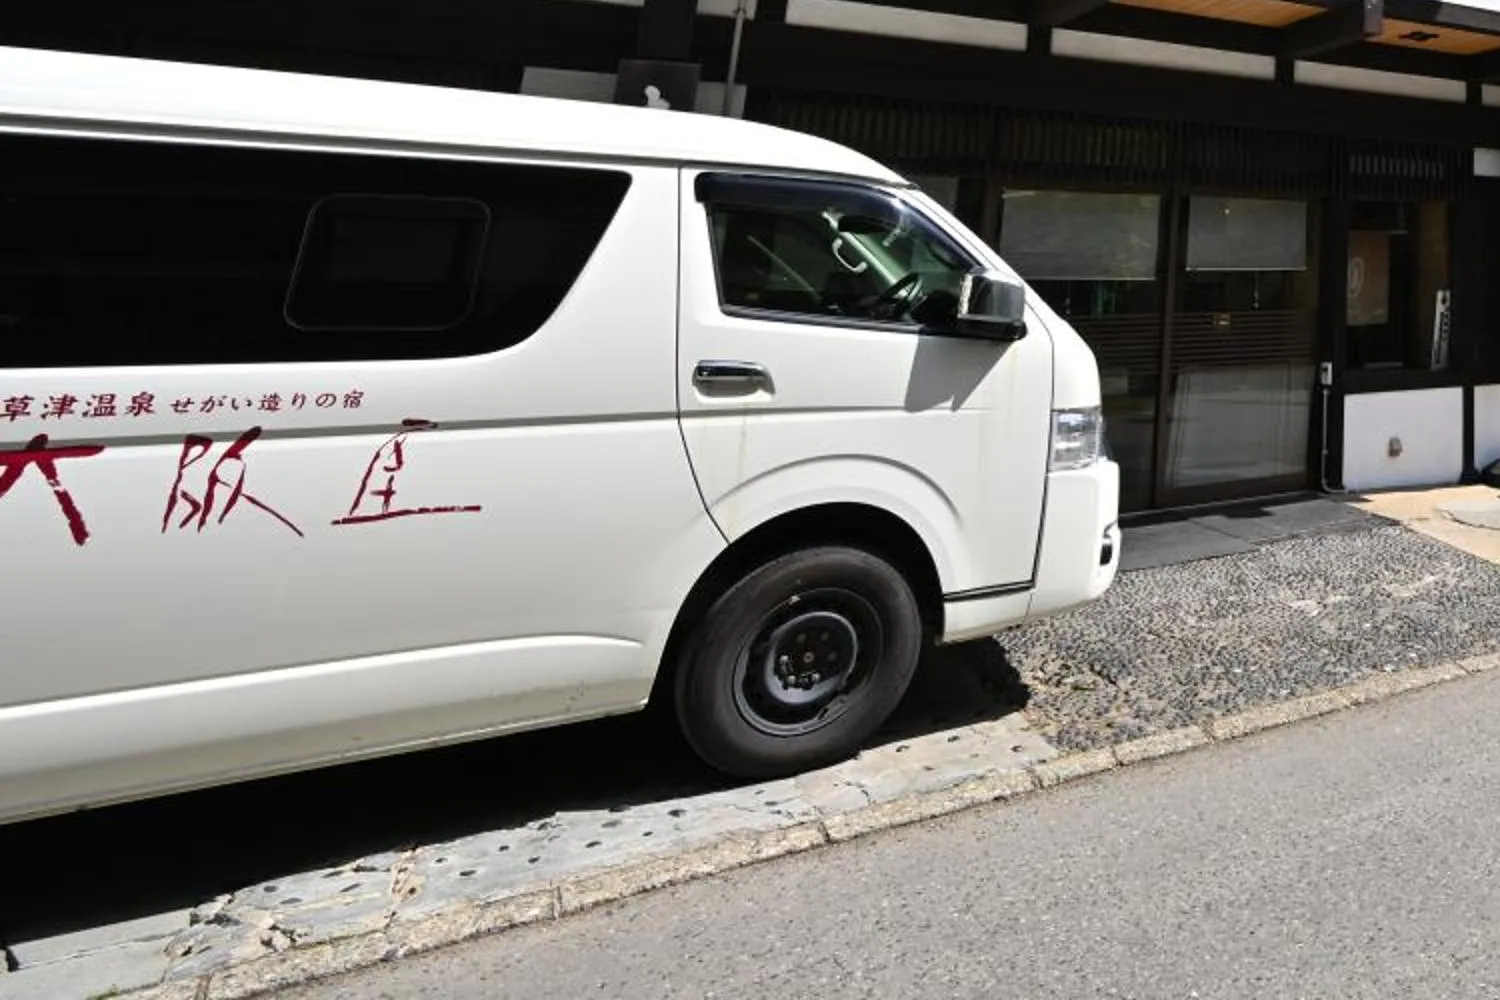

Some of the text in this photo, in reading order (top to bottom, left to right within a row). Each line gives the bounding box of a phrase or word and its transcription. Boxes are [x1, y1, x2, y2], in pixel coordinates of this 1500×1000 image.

[0, 390, 366, 421] 草津温泉 せがい造りの宿
